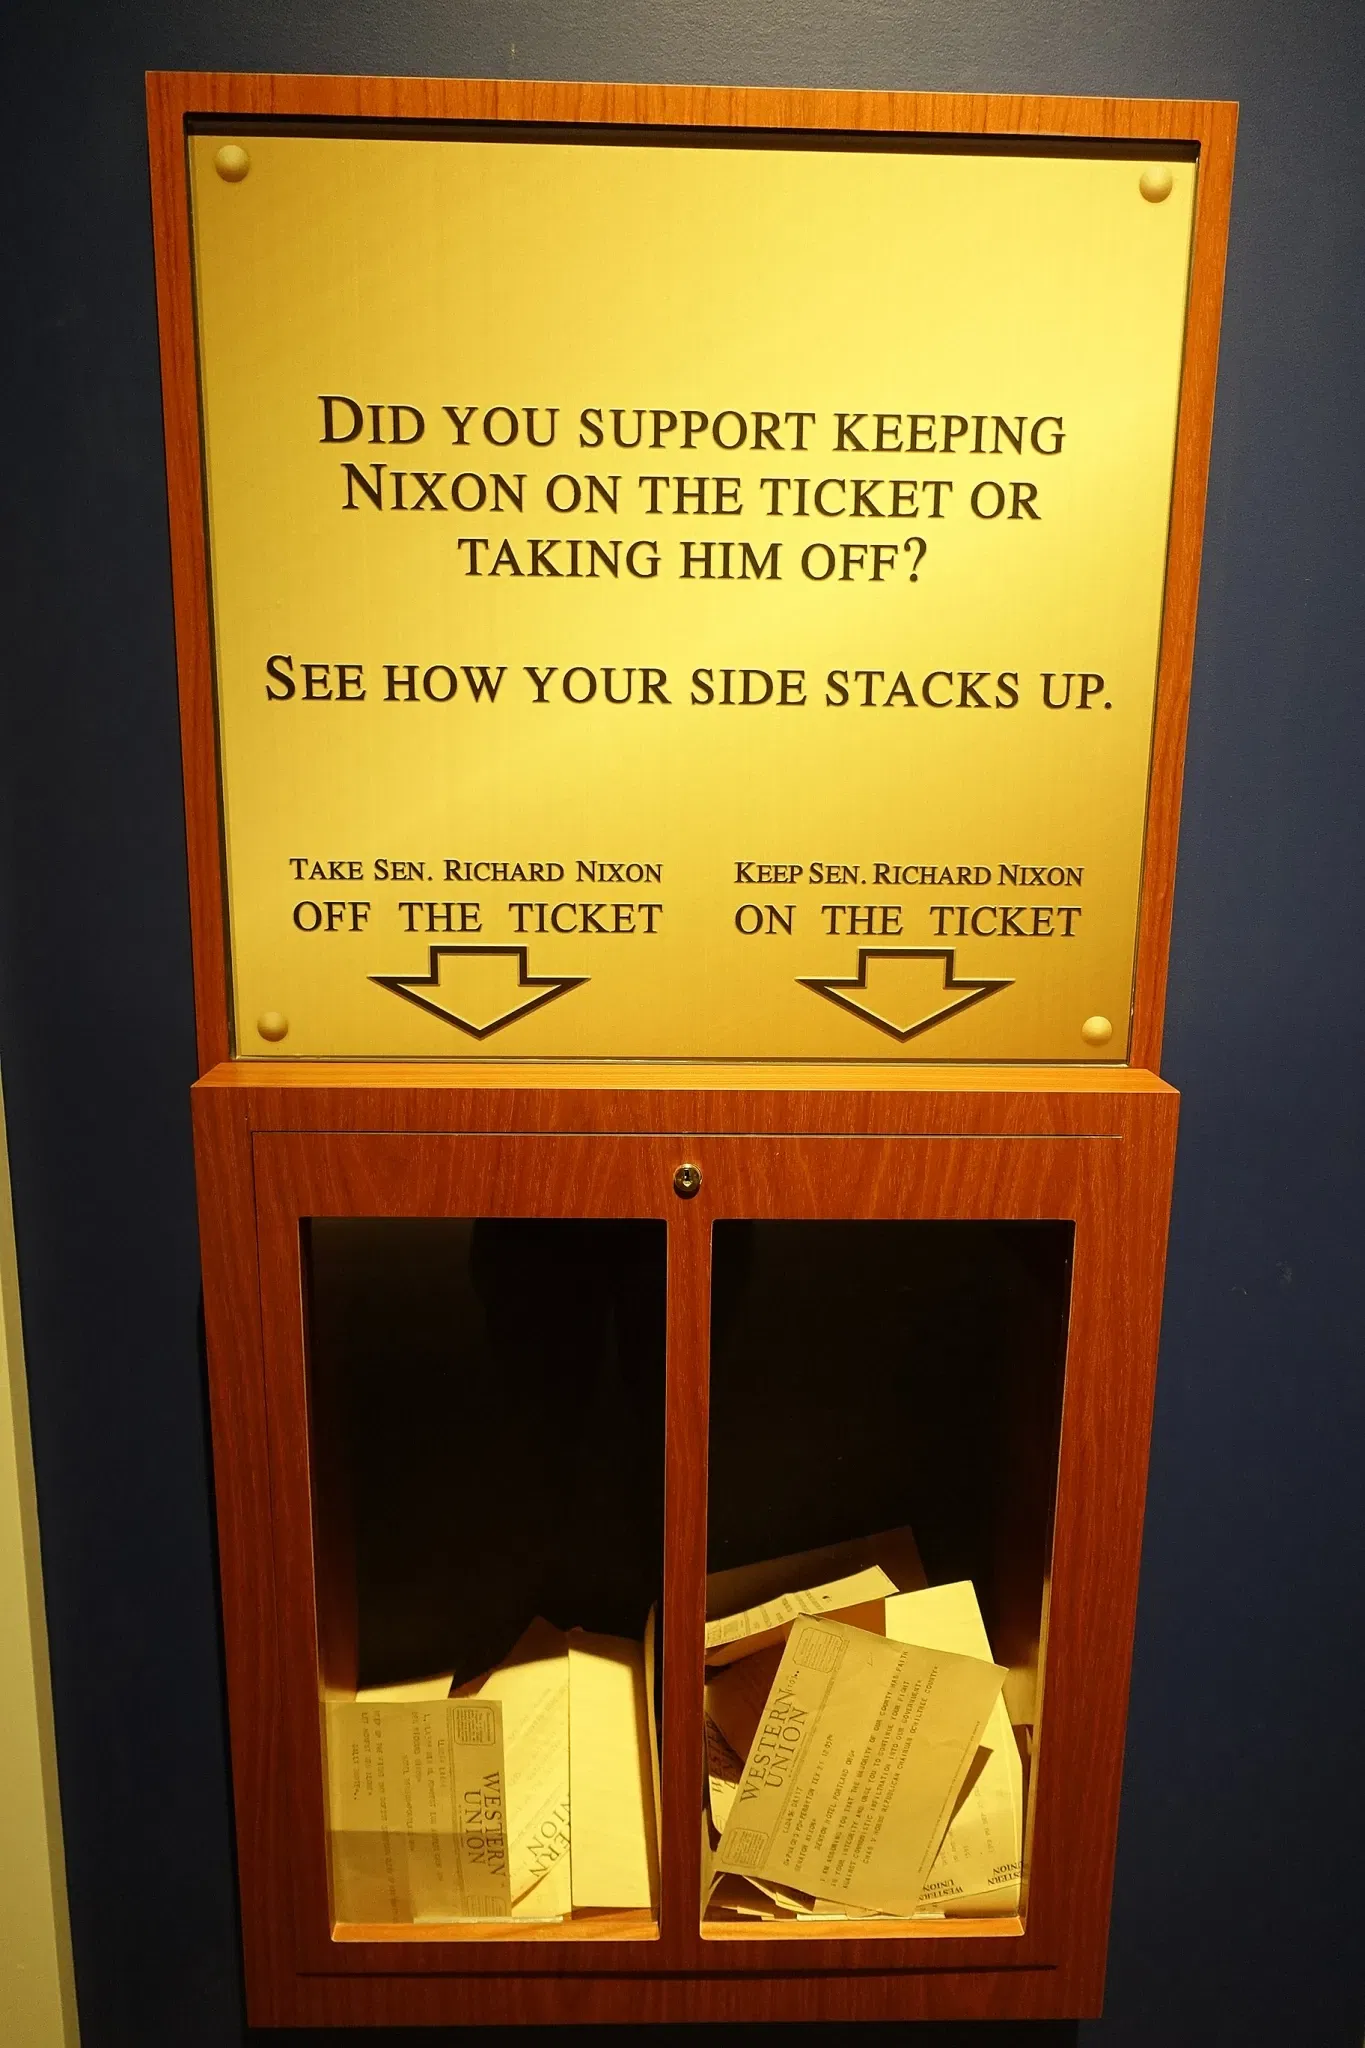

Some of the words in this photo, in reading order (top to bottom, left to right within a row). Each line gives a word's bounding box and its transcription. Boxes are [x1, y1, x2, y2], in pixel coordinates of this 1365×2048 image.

[317, 395, 425, 445] DID
[442, 406, 560, 447] YOU
[579, 408, 816, 451] SUPPORT
[832, 413, 1066, 455] KEEPING
[340, 463, 527, 513] NIXON
[546, 474, 622, 514] ON
[638, 476, 743, 515] THE
[759, 478, 953, 518] TICKET
[970, 481, 1042, 520] OR
[457, 538, 662, 579] TAKING
[679, 541, 783, 580] HIM
[801, 536, 927, 583] OFF?
[265, 654, 367, 701] SEE
[382, 664, 508, 703] HOW
[523, 666, 672, 704] YOUR
[690, 668, 807, 706] SIDE
[825, 670, 1019, 709] STACKS
[1040, 673, 1112, 710] UP.
[289, 858, 364, 881] TAKE
[374, 858, 433, 881] SEN.
[443, 859, 565, 882] RICHARD
[575, 860, 663, 883] NIXON
[734, 861, 804, 884] KEEP
[809, 862, 867, 885] SEN.
[873, 863, 992, 885] RICHARD
[997, 864, 1084, 887] NIXON
[293, 900, 371, 932] OFF
[398, 902, 483, 933] THE
[508, 902, 663, 934] TICKET
[734, 904, 797, 935] ON
[821, 905, 904, 936] THE
[929, 906, 1082, 937] TICKET
[739, 1688, 794, 1801] WESTERN
[763, 1705, 808, 1788] UNION
[837, 1815, 848, 1828] YOU
[843, 1795, 854, 1812] THAT
[849, 1781, 860, 1793] THE
[895, 1650, 909, 1672] FAITH
[855, 1805, 865, 1818] AND
[867, 1769, 877, 1783] YOU
[896, 1680, 910, 1702] FIGHT
[482, 1771, 506, 1877] WESTERN
[824, 1803, 837, 1824] HOTEL
[832, 1768, 849, 1801] PORTLAND
[463, 1789, 486, 1865] UNION
[526, 1802, 570, 1857] NION
[922, 1879, 955, 1893] UNION
